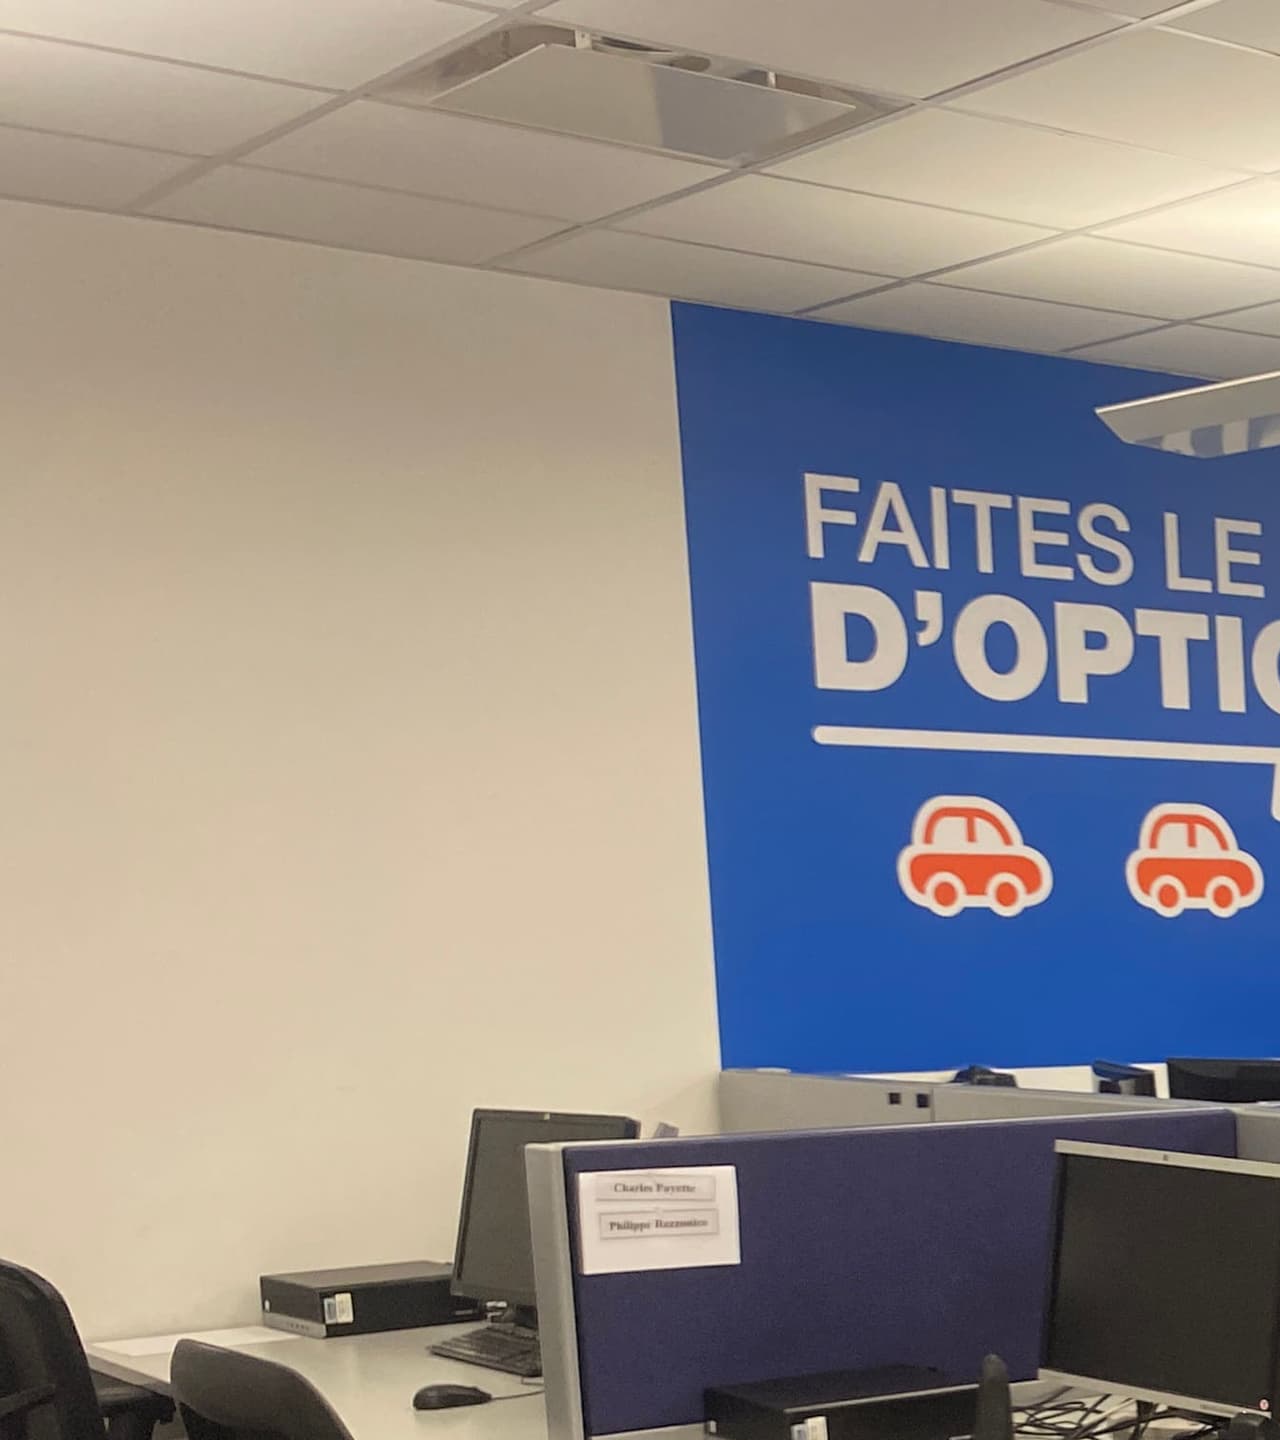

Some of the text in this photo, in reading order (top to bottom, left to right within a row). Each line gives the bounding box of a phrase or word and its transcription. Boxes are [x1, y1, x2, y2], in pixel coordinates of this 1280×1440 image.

[804, 472, 1135, 587] FAITES
[1163, 511, 1266, 598] LE
[613, 1181, 653, 1193] Charles
[609, 1220, 651, 1232] Philippe
